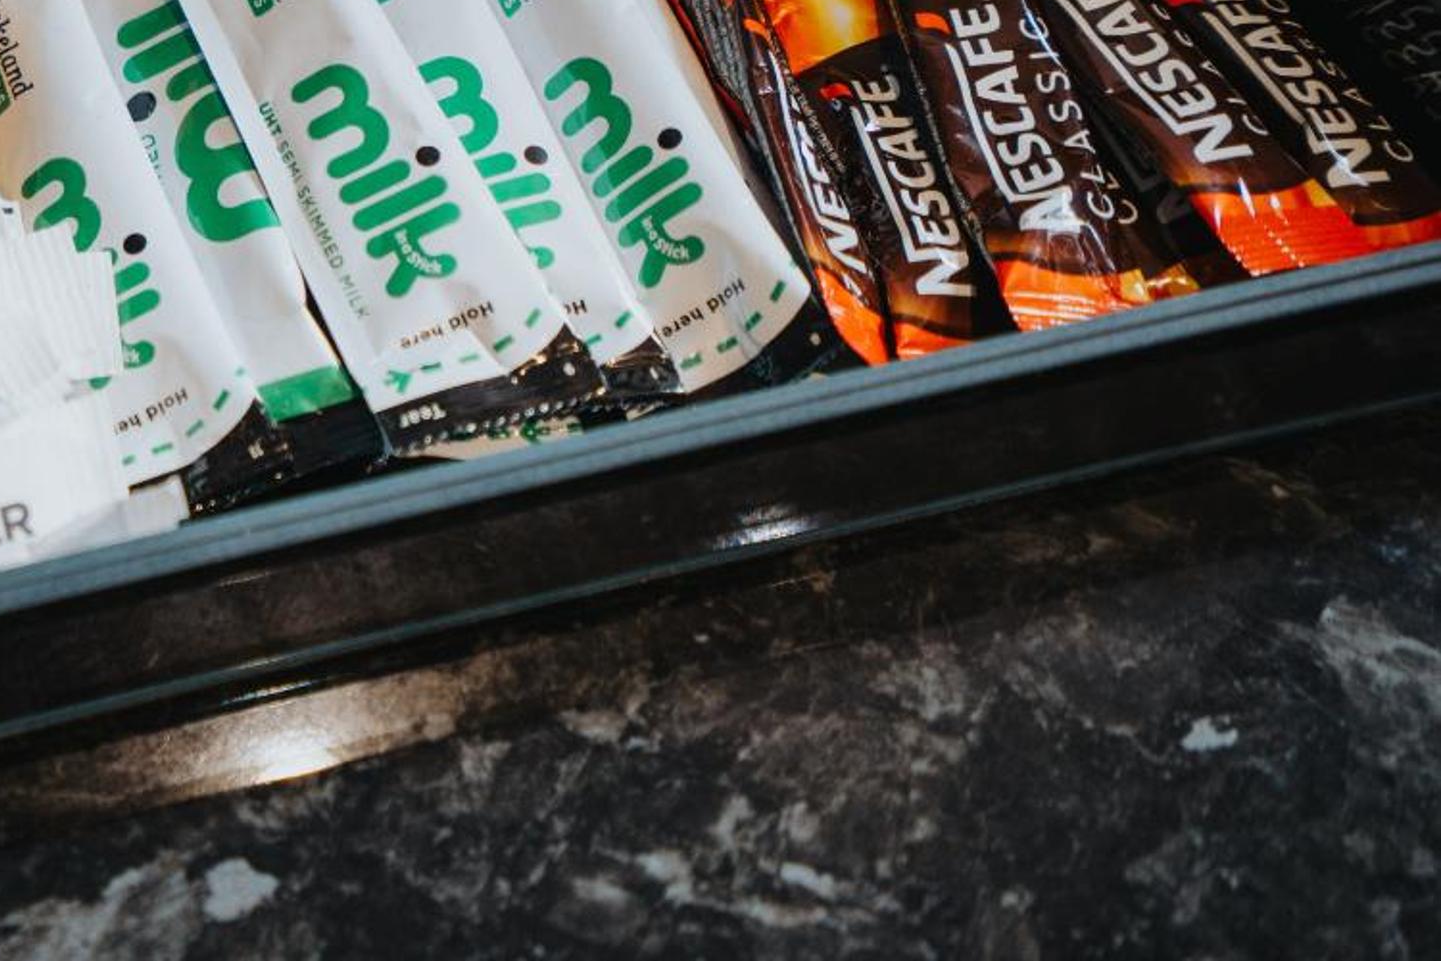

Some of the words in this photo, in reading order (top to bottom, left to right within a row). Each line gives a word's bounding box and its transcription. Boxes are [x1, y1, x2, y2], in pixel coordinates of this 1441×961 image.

[544, 57, 705, 288] milk
[1019, 16, 1116, 221] CLASSIC
[259, 102, 283, 137] UHT
[279, 139, 304, 183] SEMI
[297, 183, 345, 271] SKIMMED
[340, 273, 371, 320] MILK
[291, 63, 461, 299] milk
[448, 301, 494, 330] Hold
[662, 308, 706, 339] here
[706, 279, 746, 308] Hold
[147, 388, 190, 422] Hold
